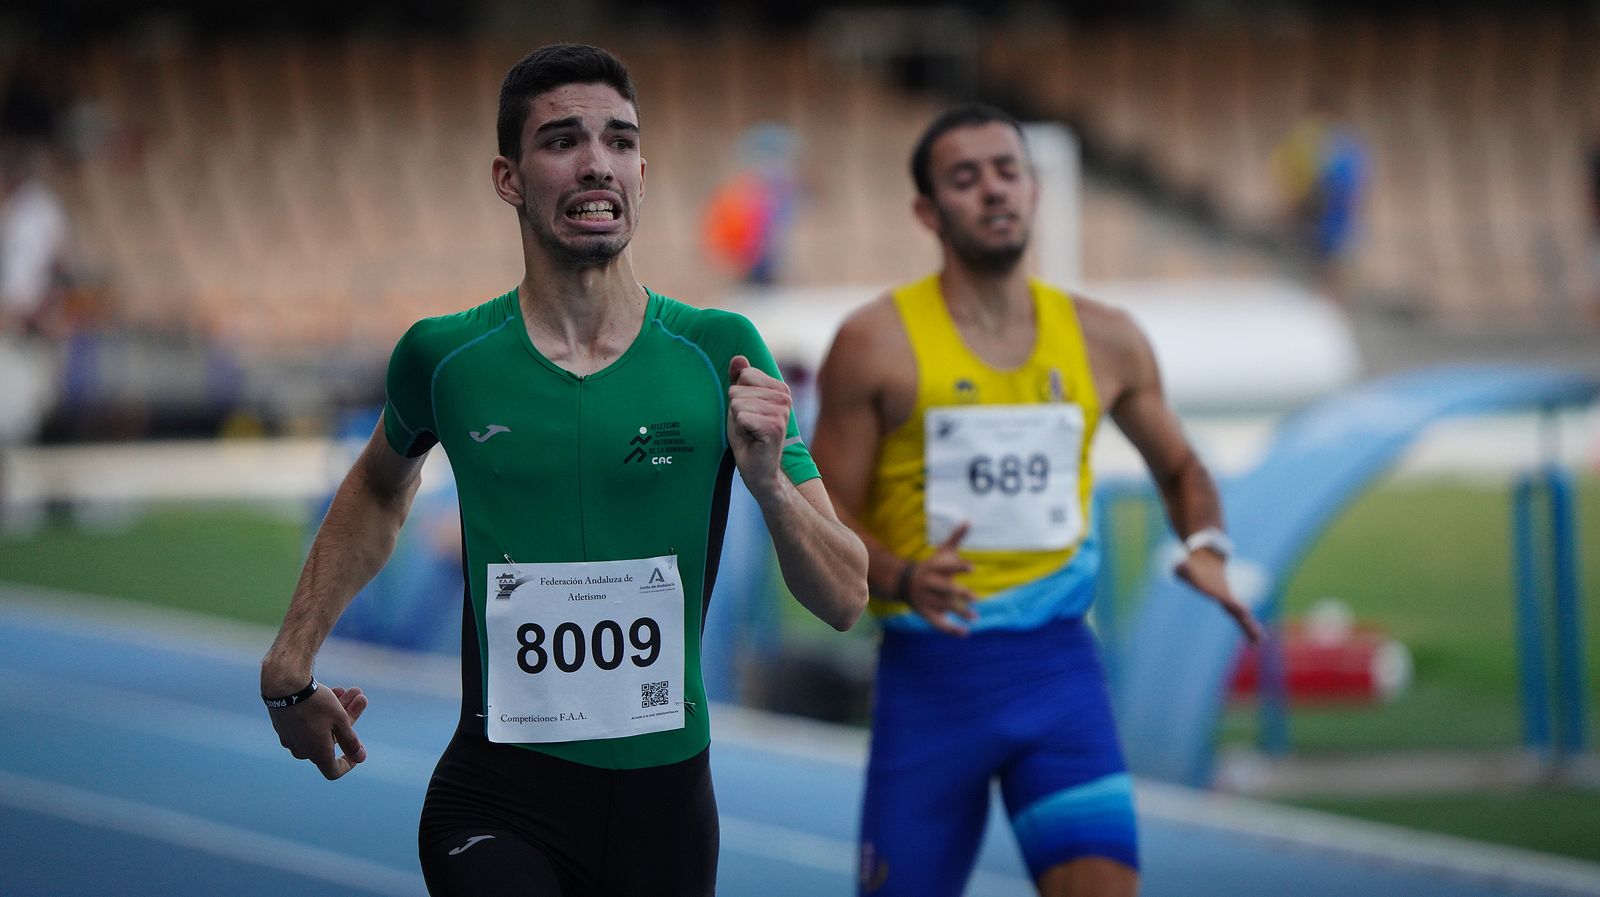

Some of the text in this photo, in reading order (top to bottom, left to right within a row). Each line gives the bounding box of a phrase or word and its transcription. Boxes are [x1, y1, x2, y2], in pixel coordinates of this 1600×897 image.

[652, 456, 672, 465] CAC
[968, 454, 1049, 496] 689
[540, 574, 633, 586] Federación Andaluza de
[567, 592, 607, 601] Atletismo
[516, 617, 661, 674] 8009
[500, 712, 587, 725] Competiciones F.A.A.
